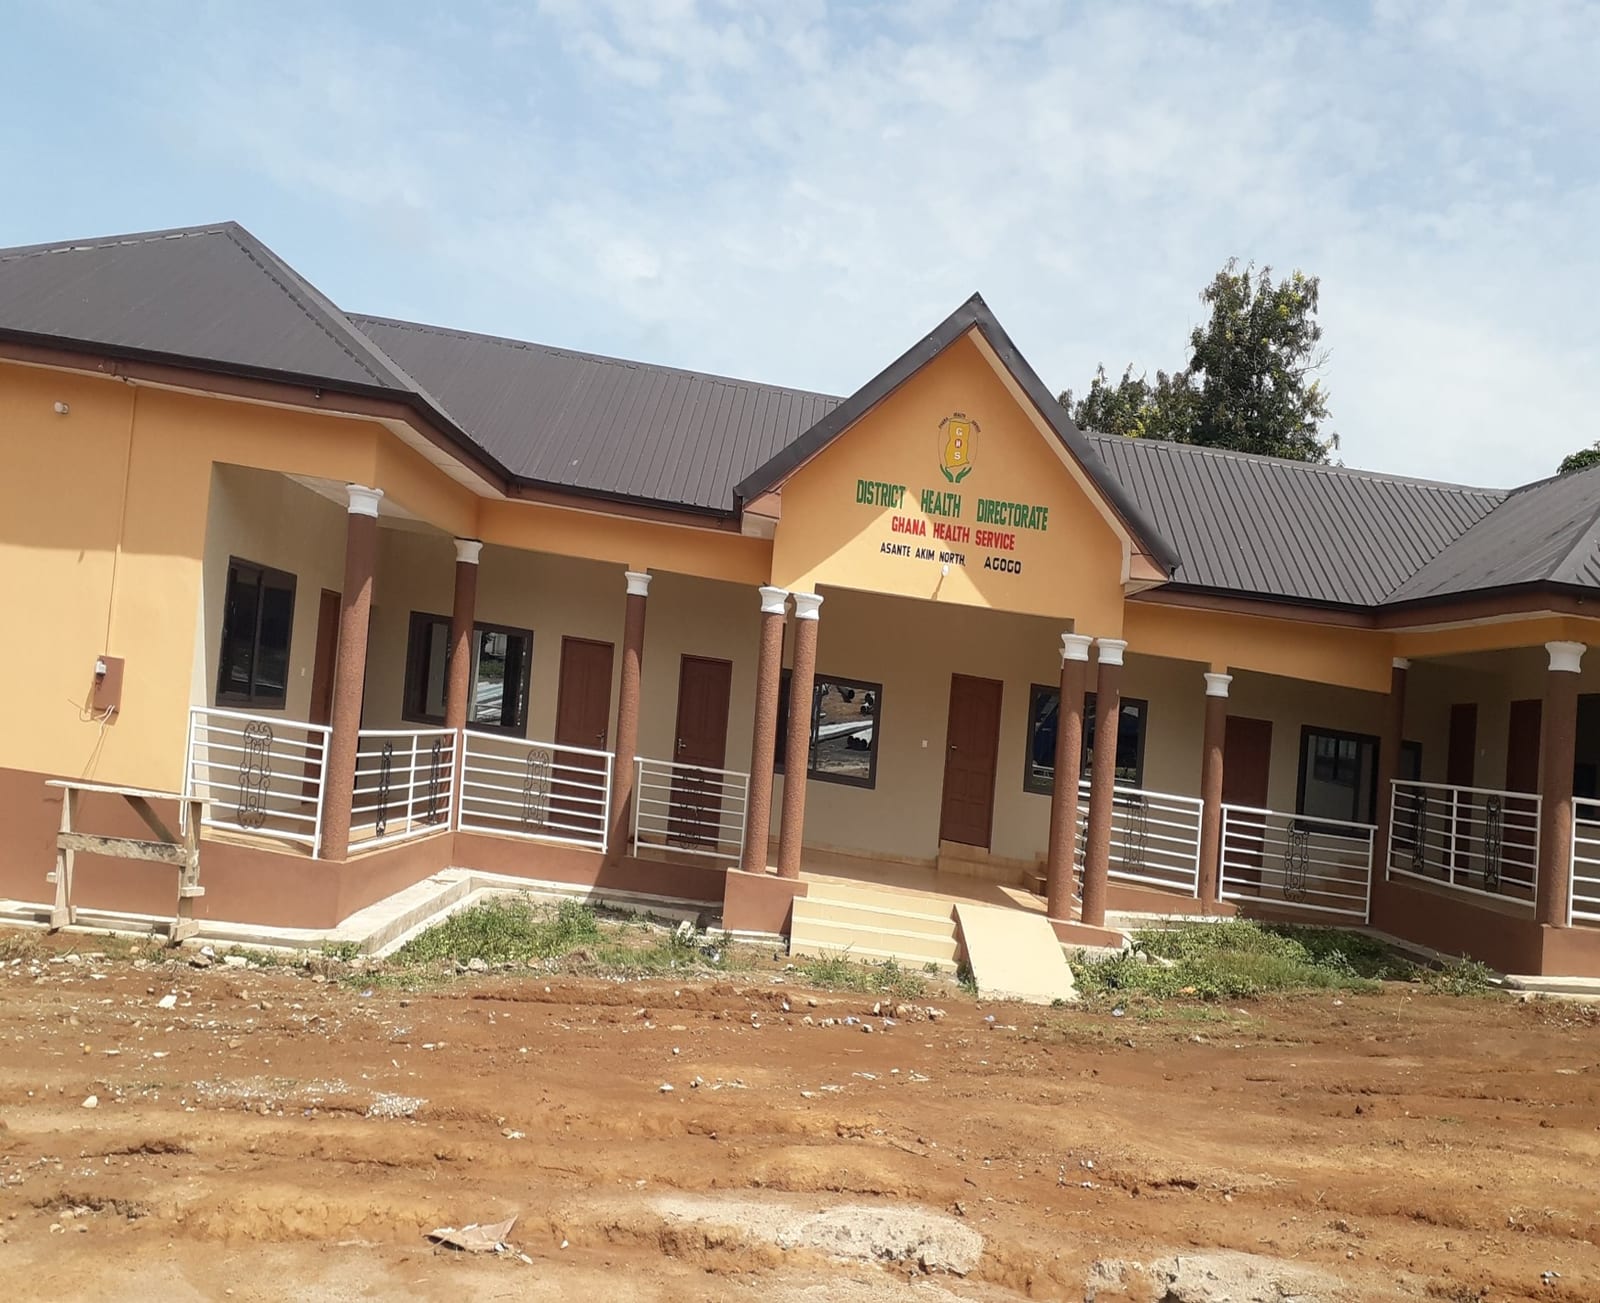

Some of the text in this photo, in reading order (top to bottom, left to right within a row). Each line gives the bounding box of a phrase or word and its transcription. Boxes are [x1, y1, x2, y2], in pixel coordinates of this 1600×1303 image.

[856, 480, 1049, 531] DISTRICT HEALTH DIRECTORATE
[891, 516, 1015, 550] GHANA HEALTH SERVICE
[880, 542, 911, 557] ASANTE
[915, 547, 935, 561] AKIM
[984, 556, 1022, 574] AGOGO
